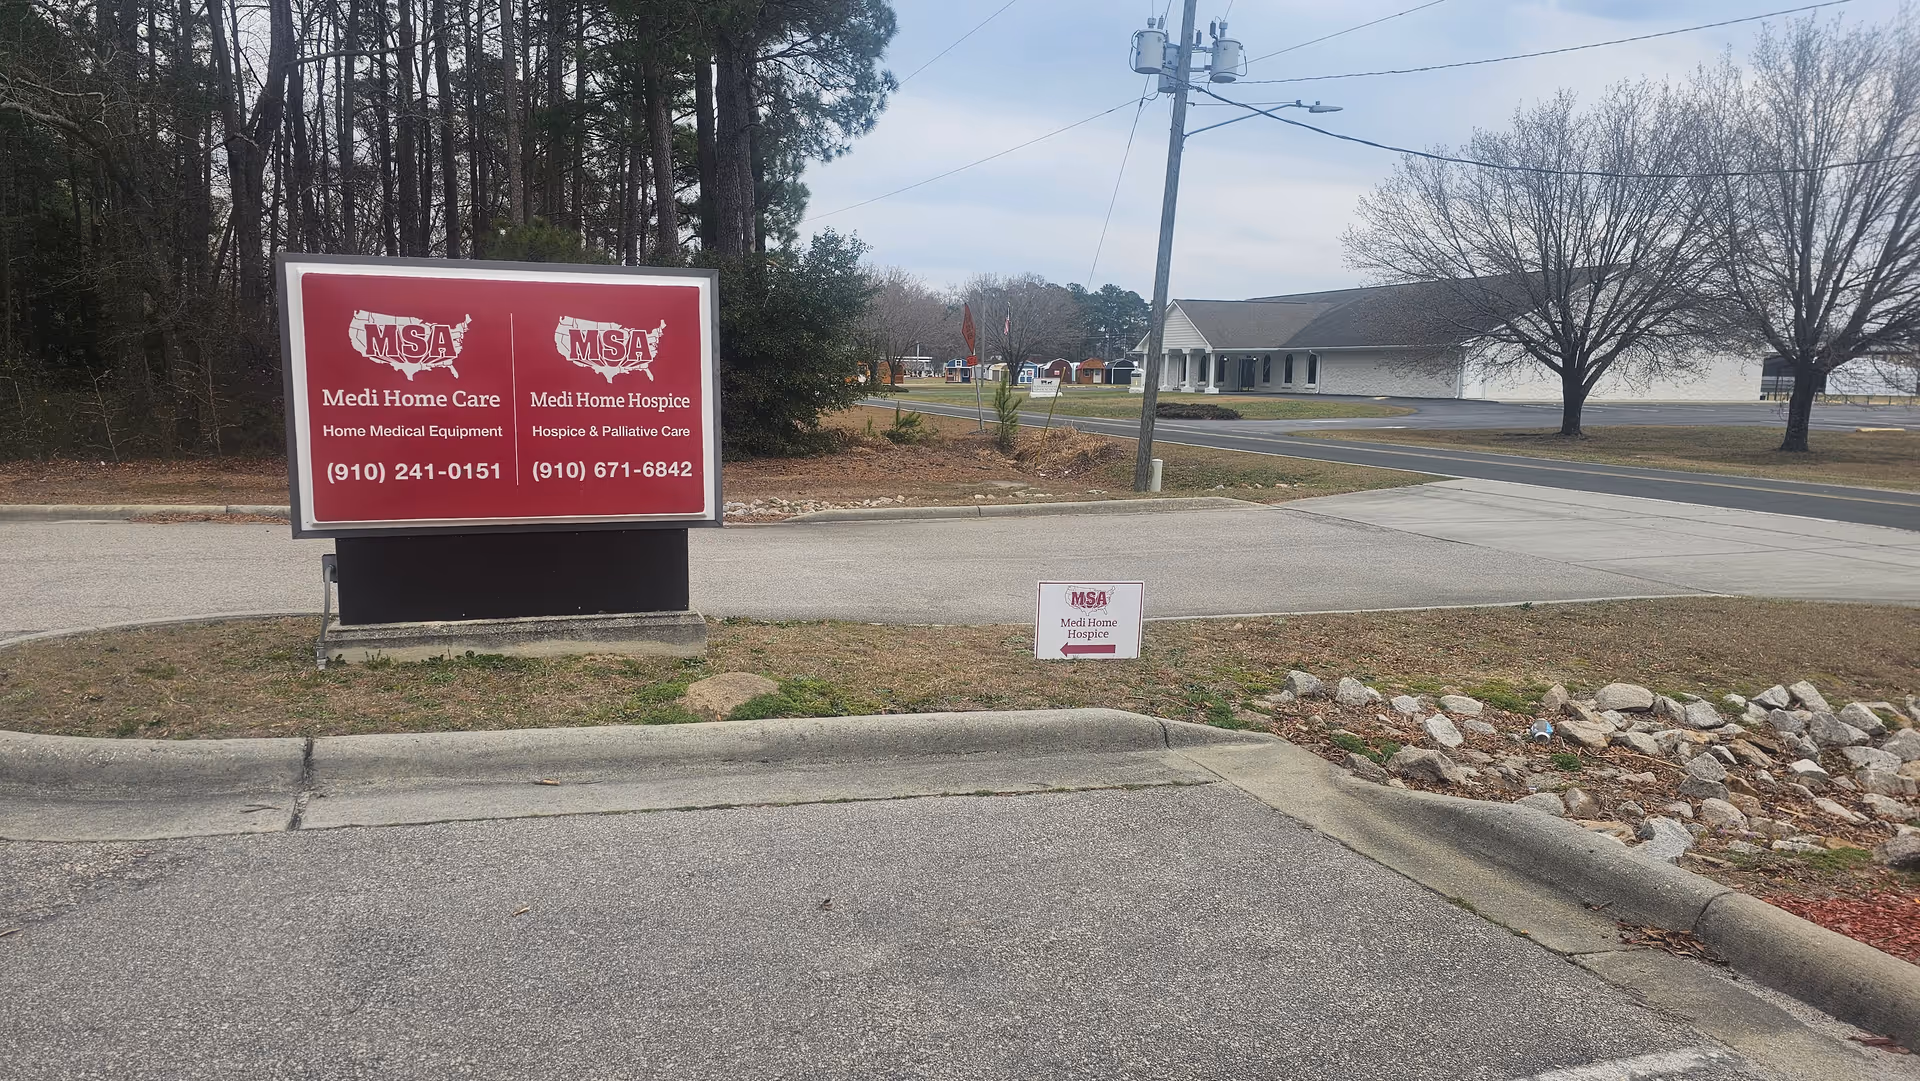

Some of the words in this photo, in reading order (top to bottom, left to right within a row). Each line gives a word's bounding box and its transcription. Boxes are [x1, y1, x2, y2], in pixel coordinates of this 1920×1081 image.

[364, 323, 458, 359] MSA
[569, 329, 654, 362] MSA
[322, 387, 380, 408] Medi
[382, 389, 448, 408] Home
[452, 390, 501, 408] Care
[530, 391, 574, 408] Medi
[575, 392, 625, 408] Home
[627, 392, 691, 413] Hospice
[323, 425, 367, 437] Home
[369, 425, 426, 437] Medical
[428, 425, 503, 440] Equipment
[532, 425, 586, 440] Hospice
[588, 425, 599, 437] &
[602, 425, 660, 437] Palliative
[661, 425, 691, 437] Care
[327, 462, 386, 485] (910)
[394, 462, 501, 480] 241-0151
[532, 460, 586, 482] (910)
[593, 460, 694, 479] 671-6842
[1070, 591, 1108, 608] MSA
[1060, 617, 1086, 628] Medi
[1087, 618, 1118, 628] Home
[1067, 629, 1110, 641] Hospice
